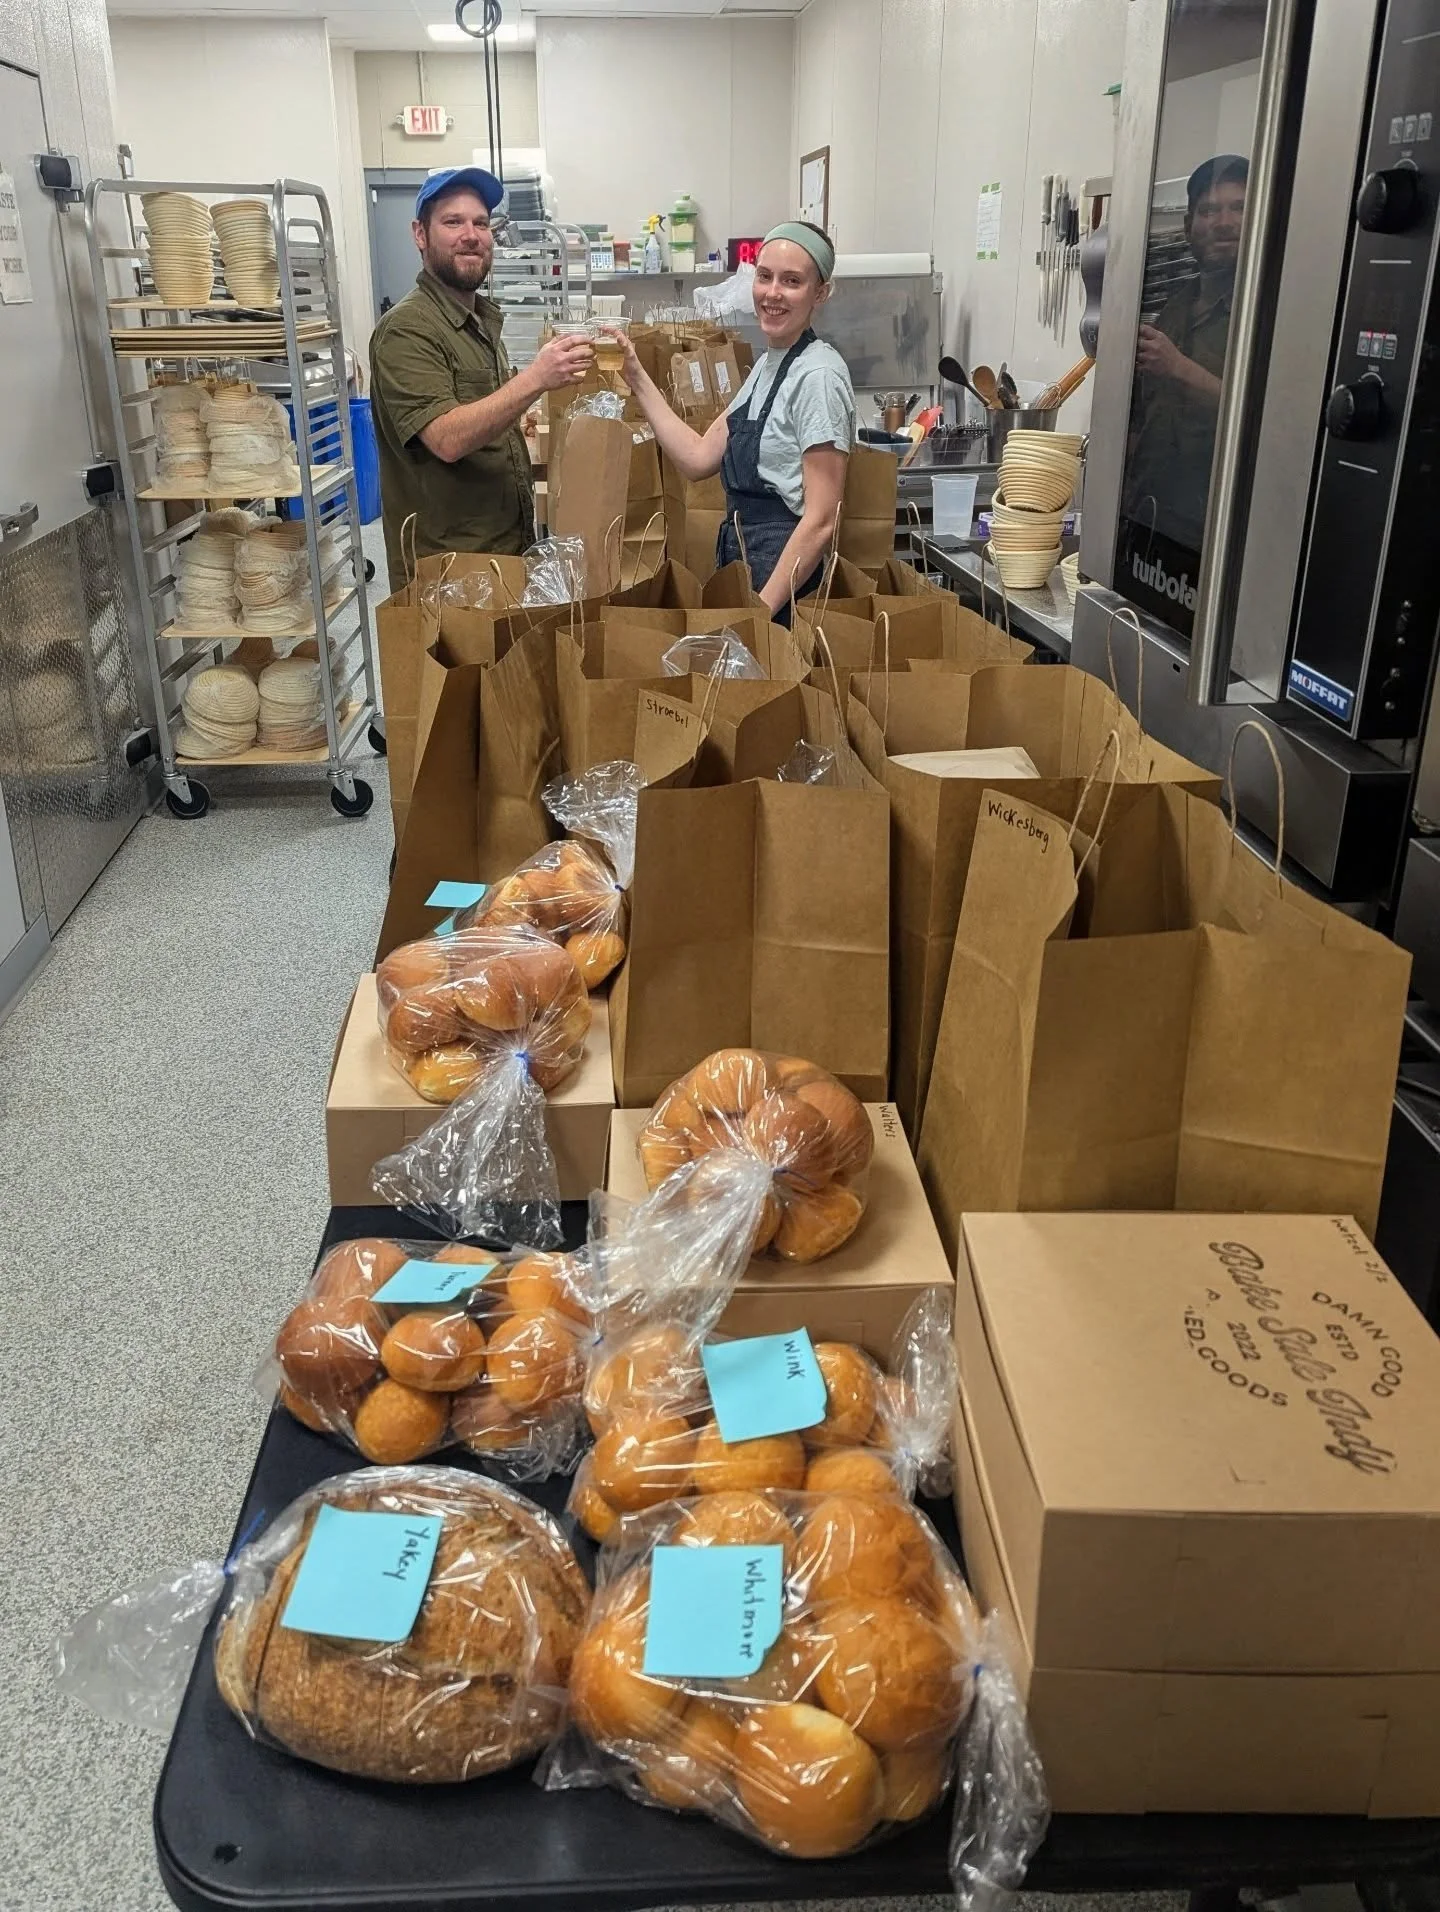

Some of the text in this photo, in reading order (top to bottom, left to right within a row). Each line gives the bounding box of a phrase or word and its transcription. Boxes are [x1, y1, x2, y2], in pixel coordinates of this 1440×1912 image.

[411, 107, 440, 132] EXIT
[1132, 551, 1199, 611] turbofa
[1291, 669, 1348, 710] MOFFAT
[784, 1339, 806, 1380] Wink
[1208, 1241, 1398, 1476] Bake Sale Indy
[1227, 1321, 1262, 1361] 2022
[1311, 1291, 1403, 1398] DAMN GOOD
[1325, 1323, 1359, 1361] ESTD
[1197, 1346, 1289, 1408] GOODS
[381, 1525, 431, 1581] Yakey
